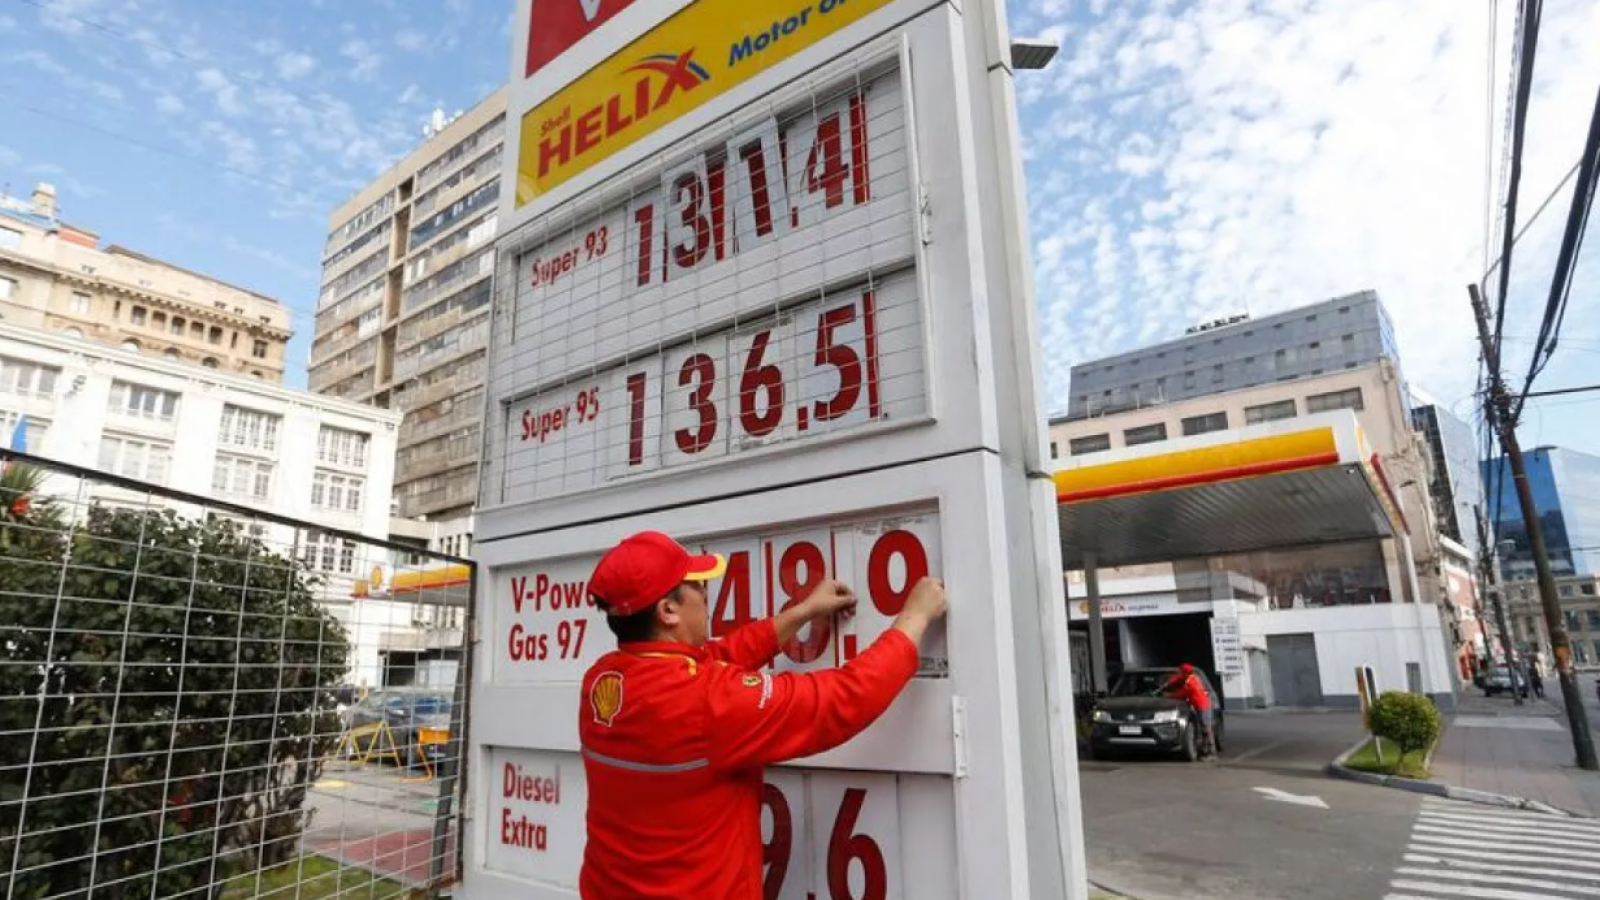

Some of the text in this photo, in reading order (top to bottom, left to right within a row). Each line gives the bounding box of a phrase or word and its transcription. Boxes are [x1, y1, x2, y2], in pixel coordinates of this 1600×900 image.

[728, 6, 812, 67] Motor
[538, 46, 702, 178] HELIX
[541, 106, 571, 135] Shell
[531, 225, 608, 287] Super 93
[626, 303, 862, 466] 136.5
[522, 386, 599, 443] Super 95
[509, 619, 587, 661] Gas 97
[503, 761, 560, 804] Diesel
[502, 808, 547, 851] Extra
